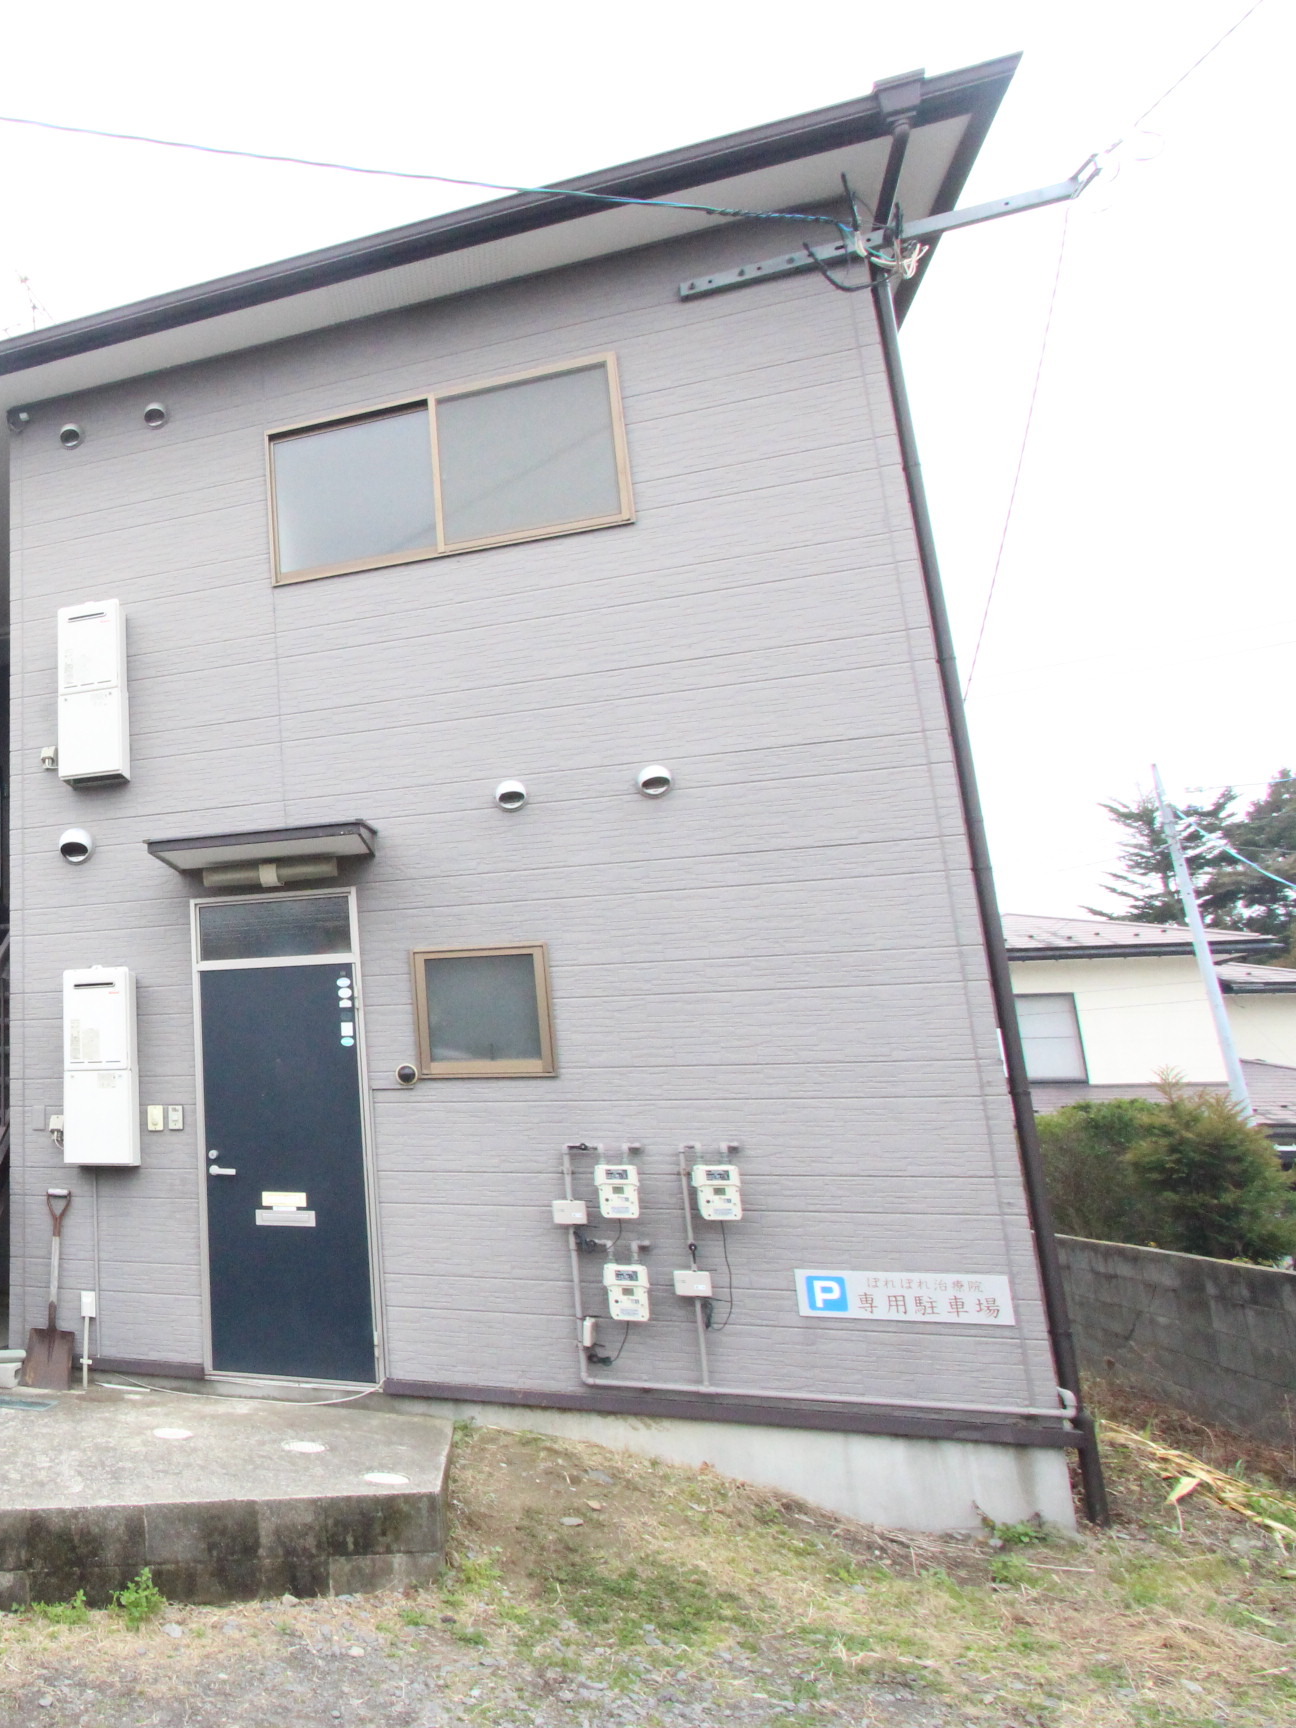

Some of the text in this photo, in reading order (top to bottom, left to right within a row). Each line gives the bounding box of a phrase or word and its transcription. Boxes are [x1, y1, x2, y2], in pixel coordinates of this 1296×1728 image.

[812, 1279, 841, 1309] P
[866, 1276, 985, 1293] ぽれぽれ治療院
[857, 1292, 1001, 1319] 専用駐車場
